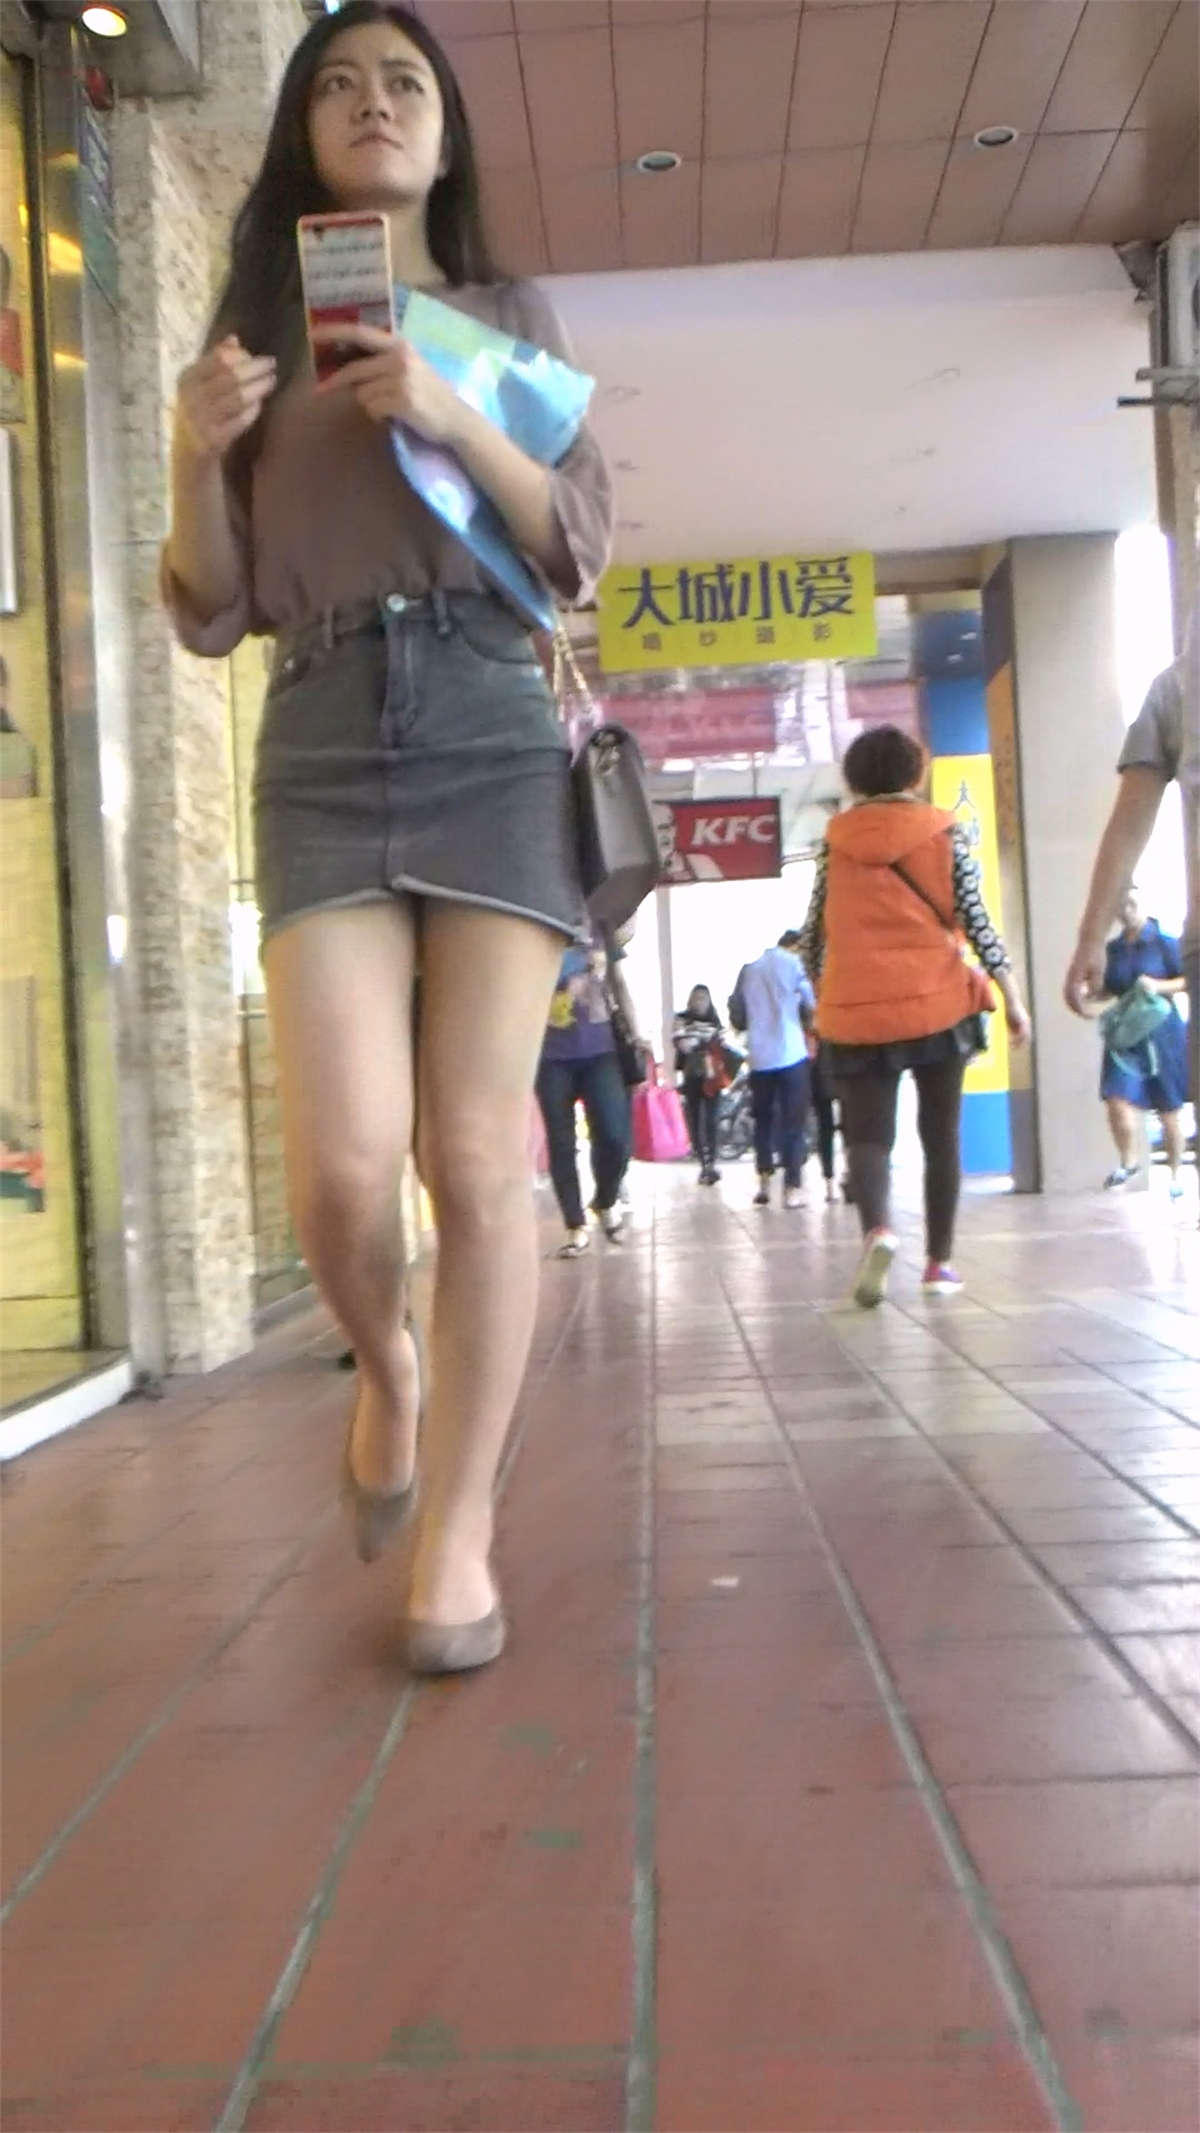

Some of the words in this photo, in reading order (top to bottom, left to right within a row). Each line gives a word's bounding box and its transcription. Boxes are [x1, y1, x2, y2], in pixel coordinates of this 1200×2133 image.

[617, 556, 855, 629] 大城小爱
[690, 813, 777, 847] KFC
